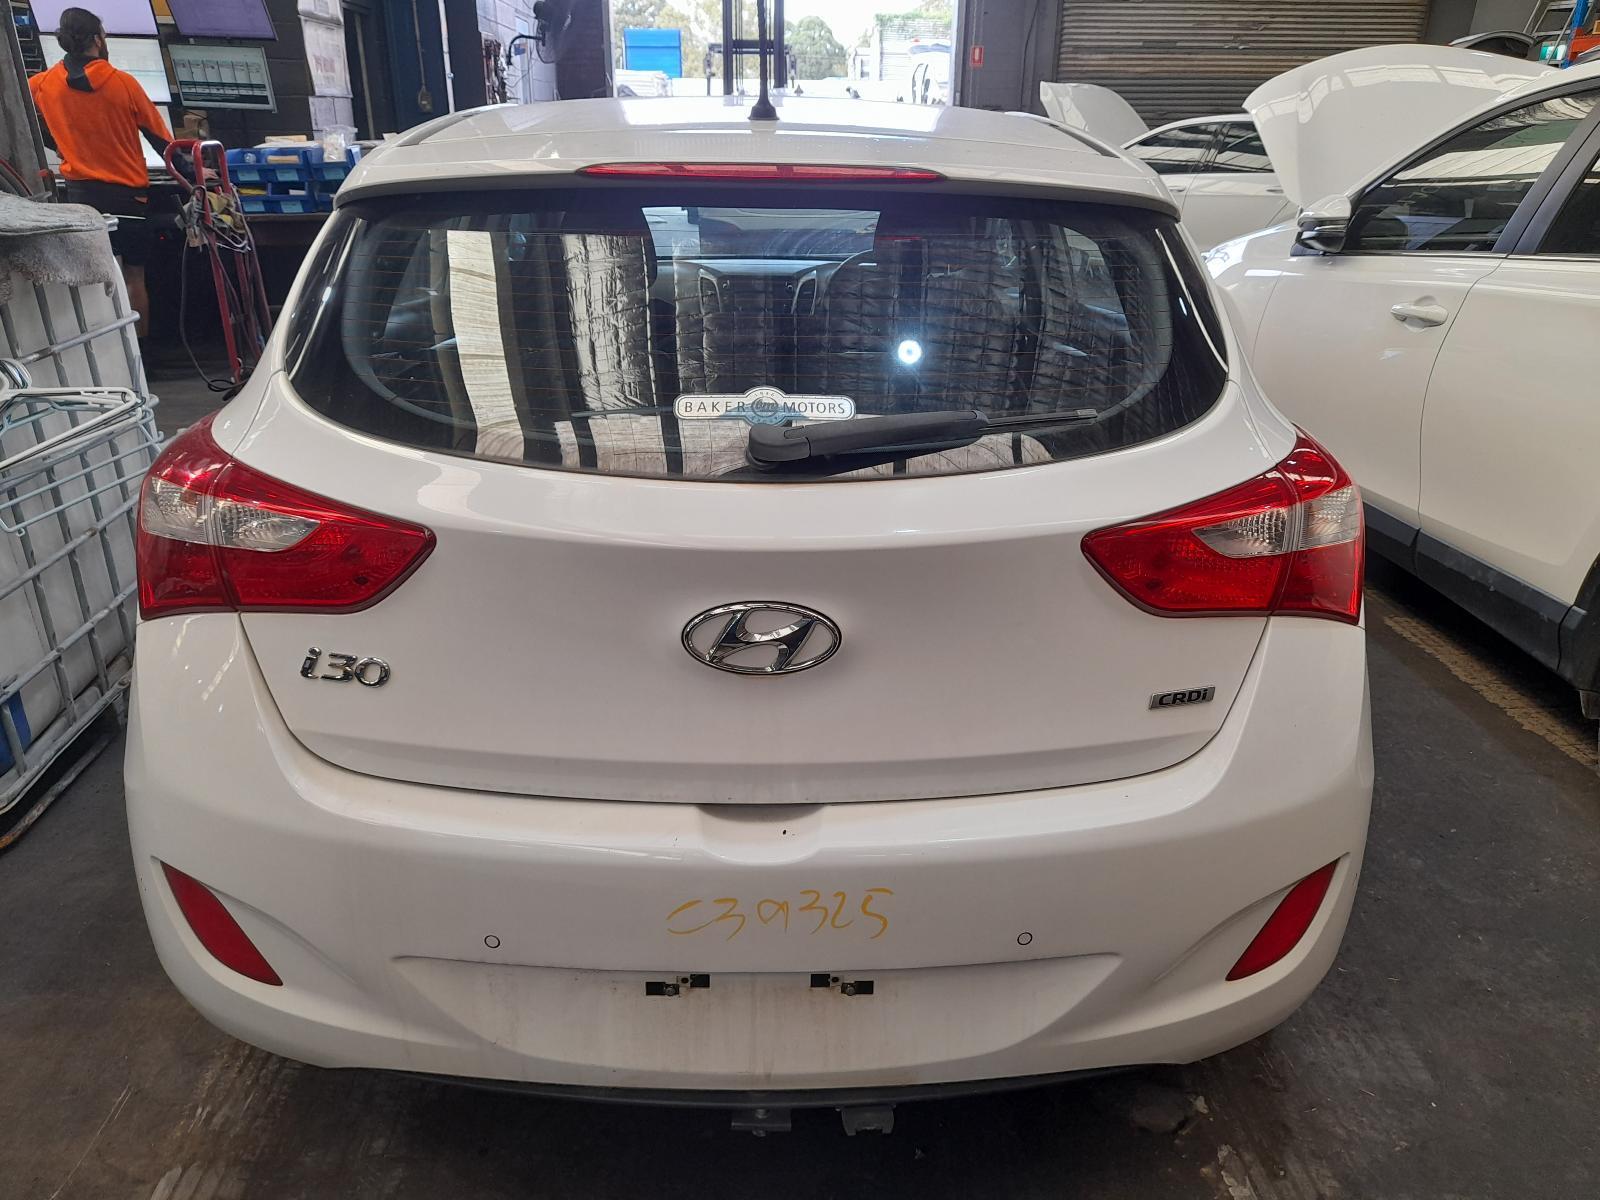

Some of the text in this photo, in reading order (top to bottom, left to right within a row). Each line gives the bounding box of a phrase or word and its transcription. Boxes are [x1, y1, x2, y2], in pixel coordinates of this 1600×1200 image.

[684, 401, 846, 414] BAKER MOTORS
[300, 646, 391, 688] i30
[1158, 689, 1209, 706] CRDi
